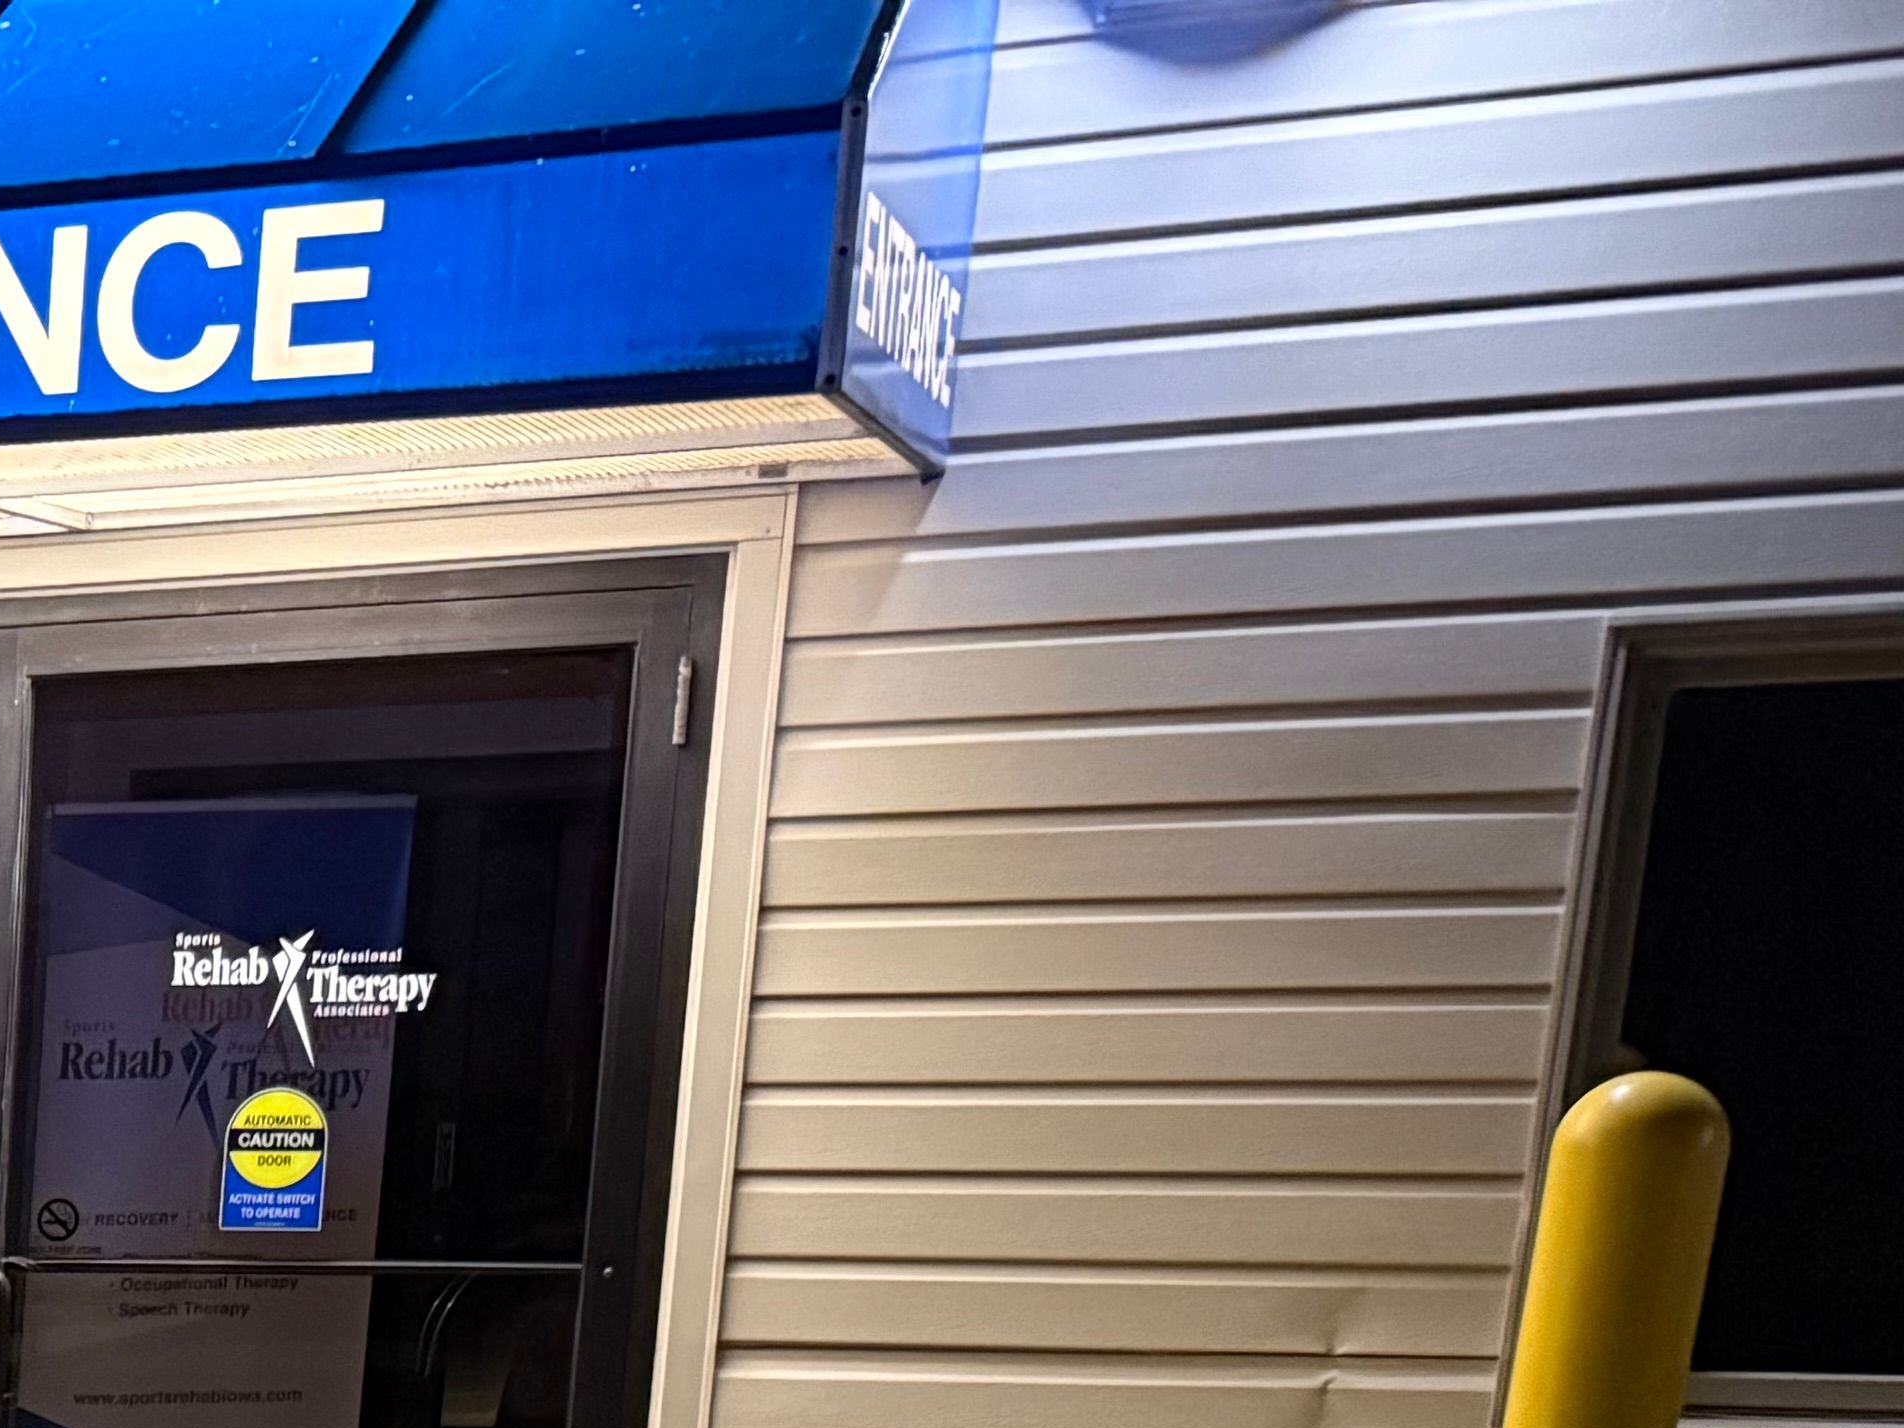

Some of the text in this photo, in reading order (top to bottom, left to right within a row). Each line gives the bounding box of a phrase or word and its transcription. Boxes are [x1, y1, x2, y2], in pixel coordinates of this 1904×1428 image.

[856, 192, 960, 409] ENTRANCE
[175, 932, 221, 948] Sports
[311, 947, 403, 965] Professional
[171, 945, 270, 986] Rehab
[306, 964, 438, 1013] Therapy
[313, 1003, 390, 1018] Associates
[58, 1038, 174, 1081] Rehab
[244, 1114, 312, 1127] AUTOMATIC
[238, 1132, 315, 1148] CAUTION
[257, 1155, 292, 1167] DOOR
[228, 1192, 316, 1206] ACTIVATE SWITCH
[94, 1210, 179, 1227] RECOVERY
[241, 1207, 301, 1220] TO OPERATE
[120, 1276, 299, 1294] Occupational Therapy
[118, 1301, 251, 1319] Speech Therapy
